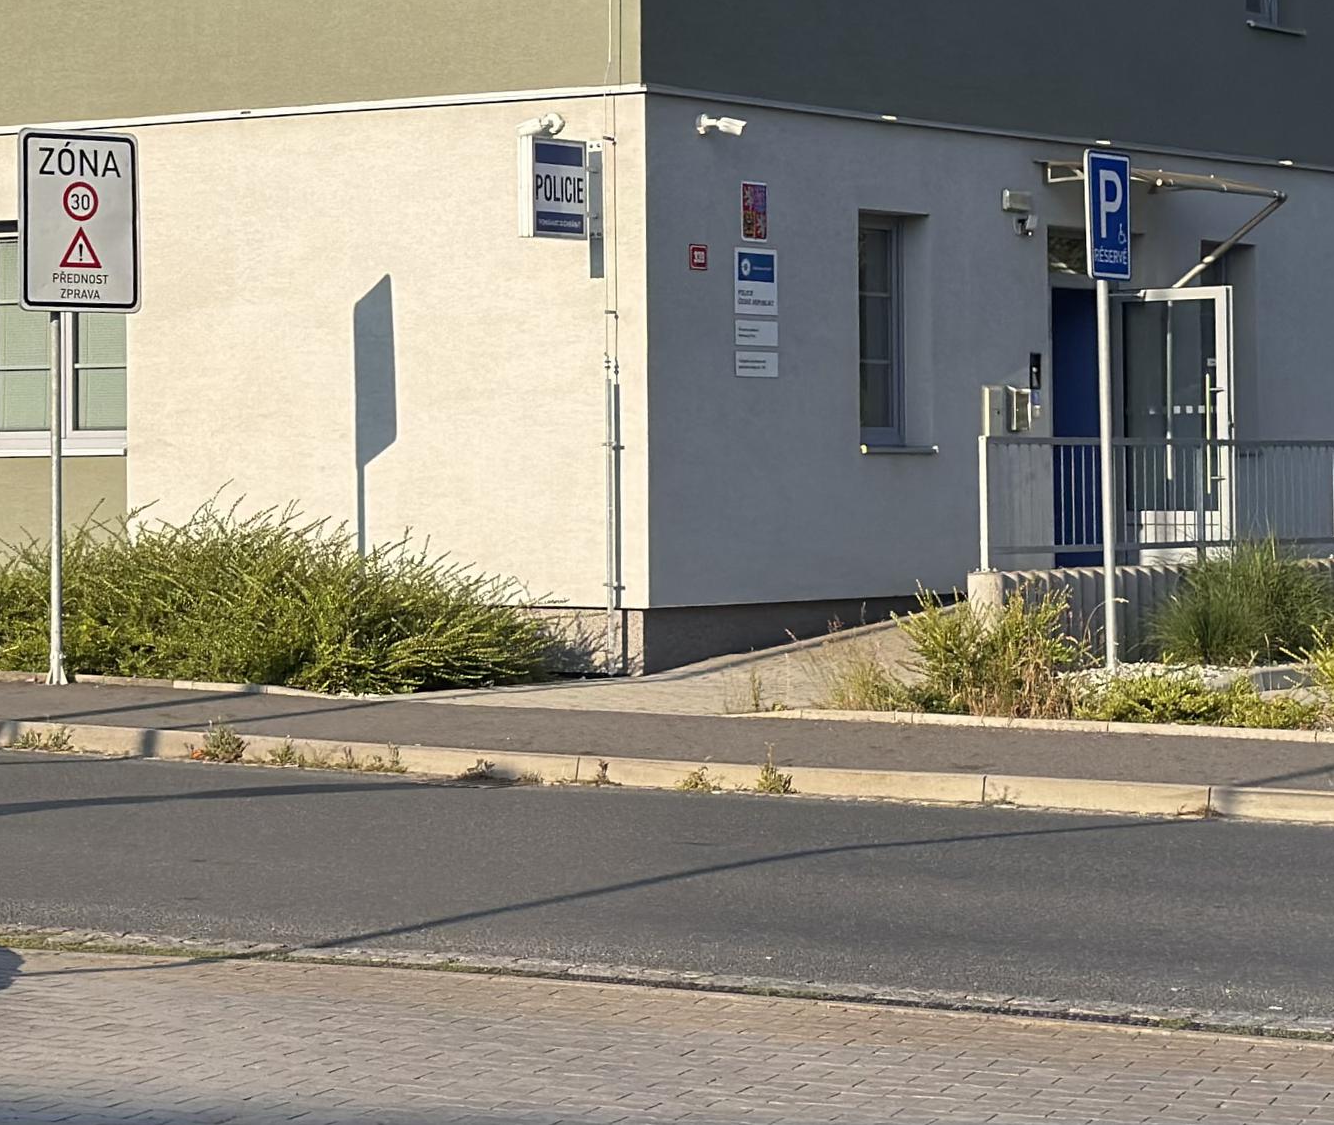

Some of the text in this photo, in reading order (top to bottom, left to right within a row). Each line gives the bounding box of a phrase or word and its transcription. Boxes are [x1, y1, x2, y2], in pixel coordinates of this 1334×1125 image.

[39, 142, 121, 178] ZÓNA
[535, 174, 584, 203] POLICIE
[70, 193, 90, 211] 30
[1099, 169, 1123, 239] P
[1094, 245, 1128, 265] RÉSERVÉ
[52, 271, 109, 285] PŘEDNOST
[60, 289, 101, 299] ZPRAVA
